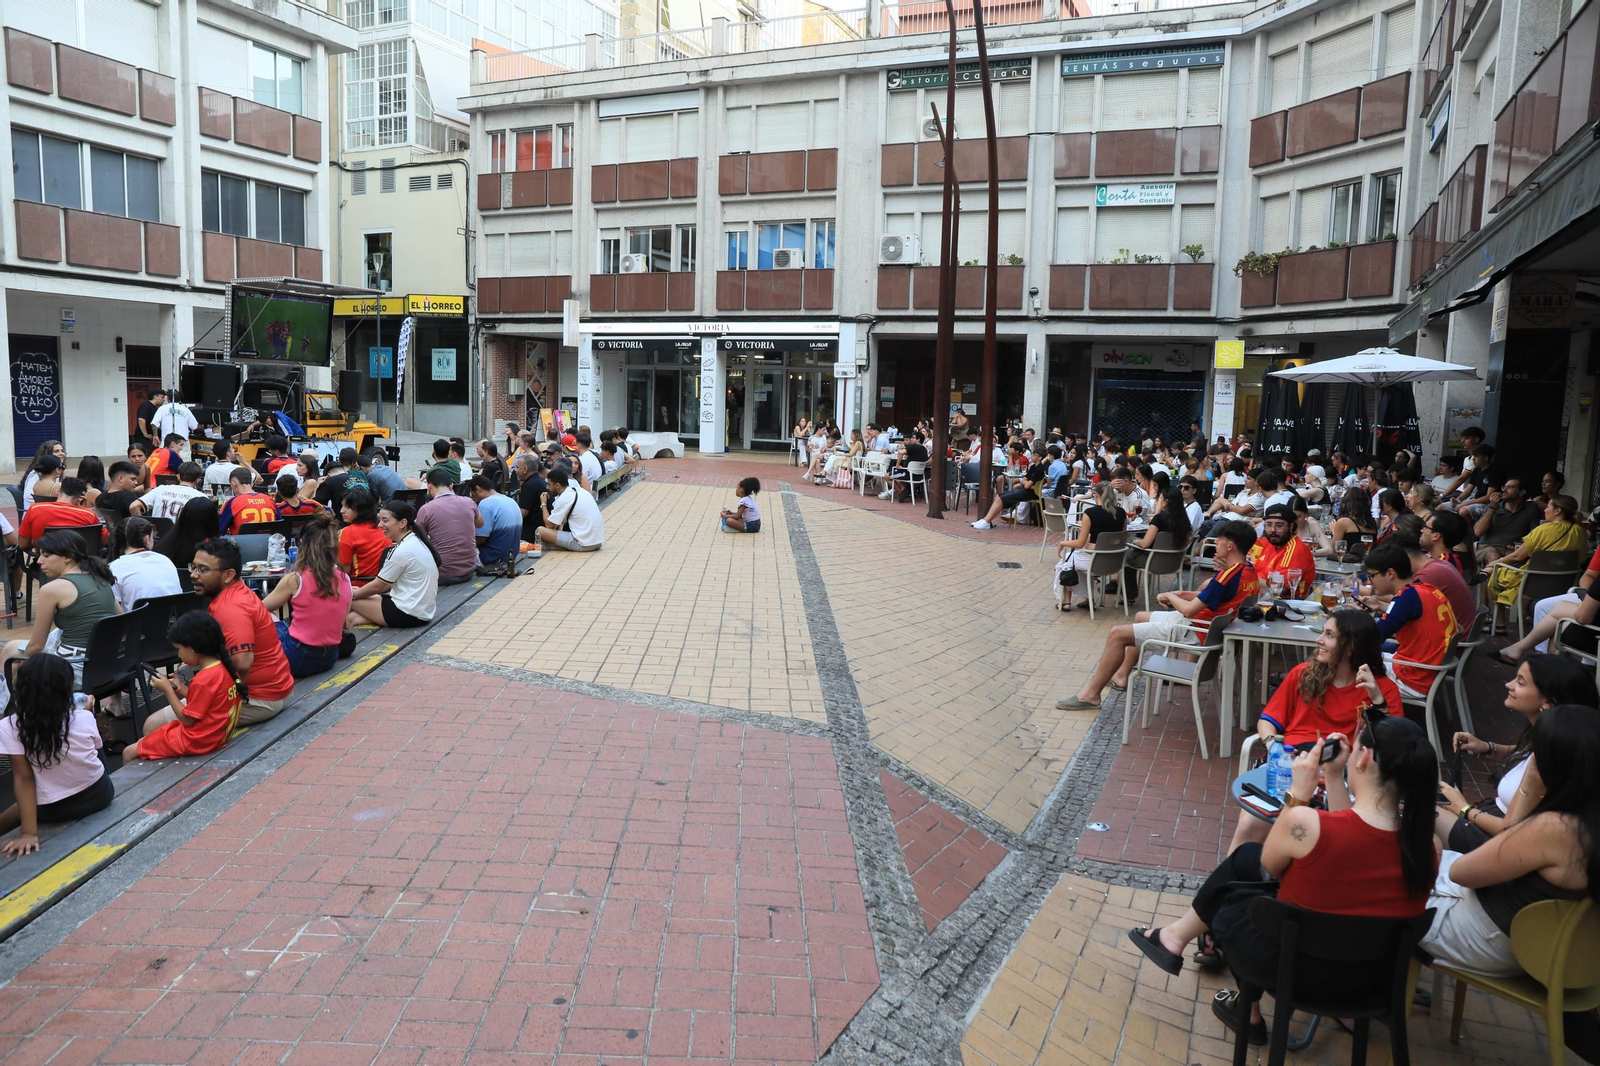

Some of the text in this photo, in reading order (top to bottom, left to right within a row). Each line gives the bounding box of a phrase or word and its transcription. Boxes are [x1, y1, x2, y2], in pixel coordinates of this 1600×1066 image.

[1063, 55, 1220, 73] RENTAS seguros
[888, 70, 949, 88] Gestorí
[1097, 186, 1137, 202] Conta
[423, 300, 461, 311] HORREO
[688, 323, 730, 331] VICTORIA
[608, 341, 643, 349] VICTORIA
[736, 341, 775, 349] VICTORIA
[20, 361, 53, 374] MATEM
[18, 371, 53, 386] AMORE
[21, 396, 53, 408] FAKO
